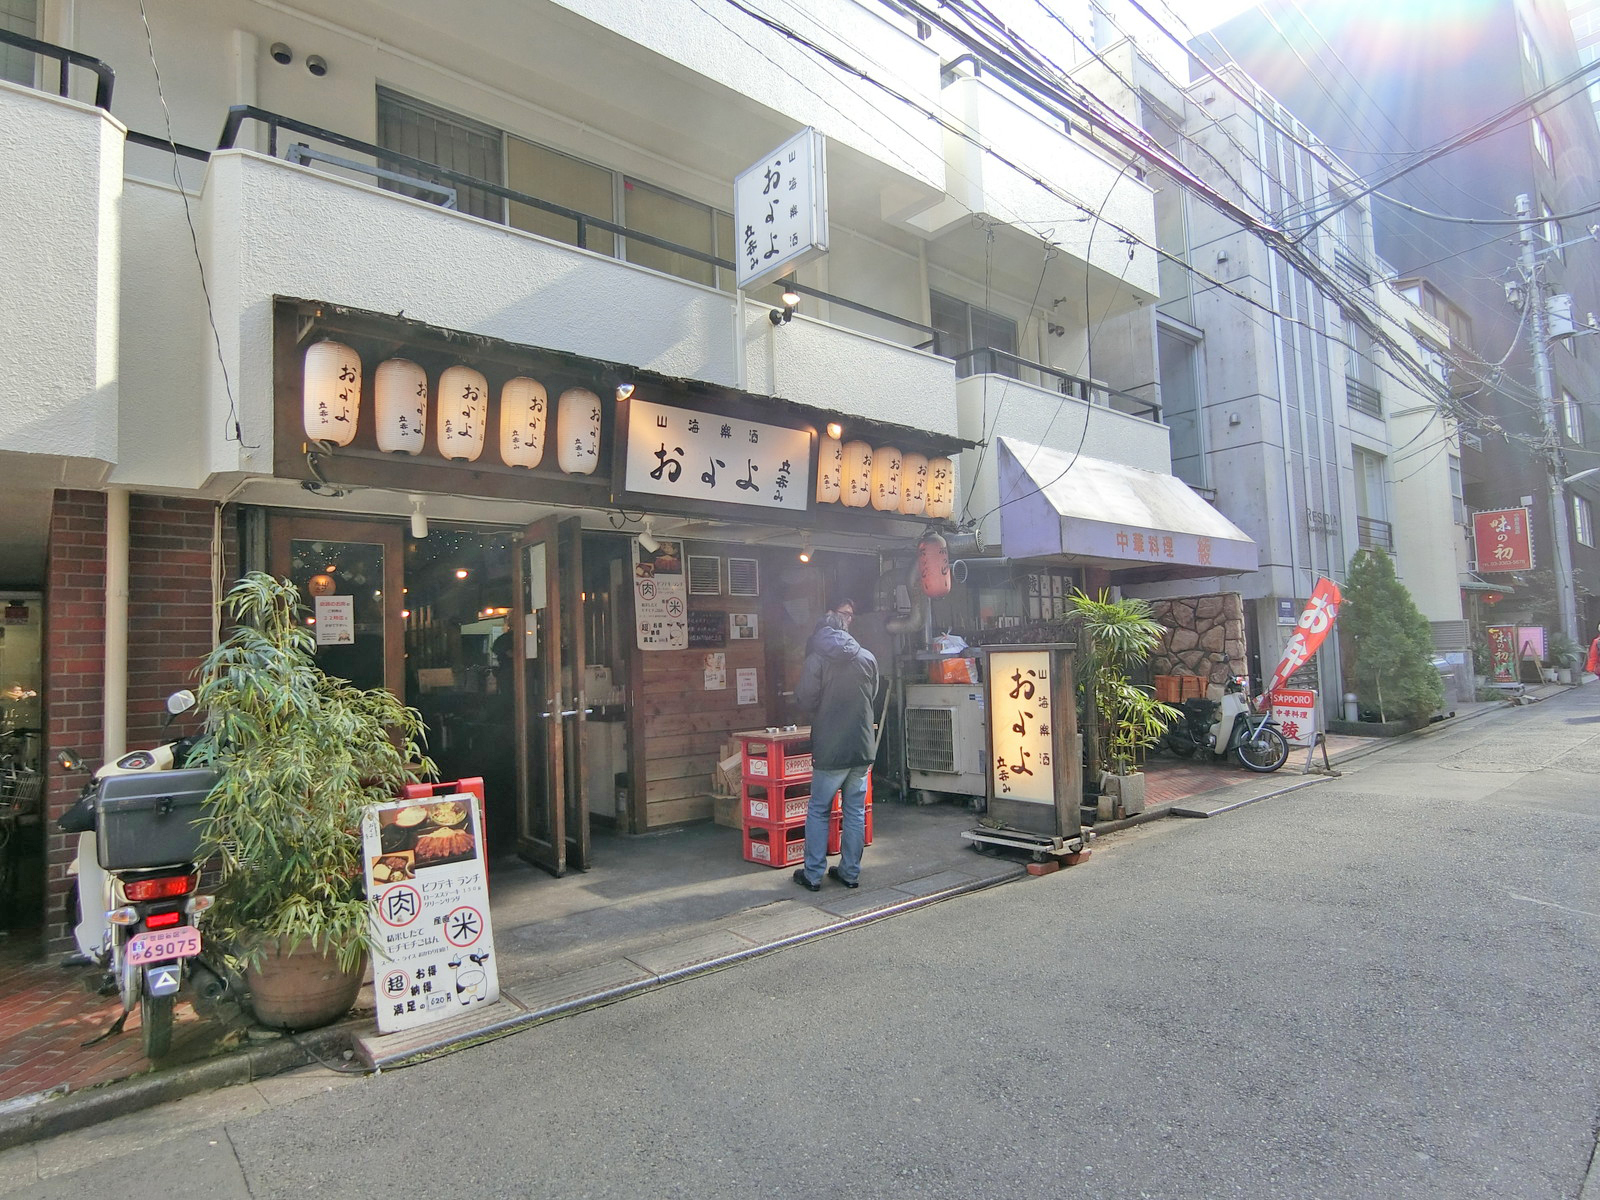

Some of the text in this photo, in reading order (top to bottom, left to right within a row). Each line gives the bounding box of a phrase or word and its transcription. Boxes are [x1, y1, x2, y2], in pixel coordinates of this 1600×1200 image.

[762, 160, 782, 260] およよ
[334, 364, 357, 423] およよ
[414, 381, 427, 436] およよ
[458, 384, 480, 438] およよ
[524, 396, 544, 448] およよ
[650, 443, 760, 492] およよ
[774, 460, 791, 502] 立呑み
[860, 454, 872, 492] およよ
[888, 459, 900, 495] およよ
[914, 464, 927, 500] およよ
[934, 468, 946, 503] およよ
[1116, 530, 1174, 558] 中華料理
[1490, 514, 1514, 560] 味の初
[642, 582, 654, 596] 肉
[670, 600, 681, 614] 米
[1493, 631, 1508, 660] 味の初
[1009, 668, 1036, 776] およよ
[1276, 709, 1308, 719] 中華料理
[1281, 720, 1301, 741] 綾
[997, 756, 1011, 793] 立呑み
[422, 874, 480, 892] ビフテキ ランチ
[388, 890, 415, 920] 肉
[387, 928, 424, 942] 精米したて
[452, 912, 478, 939] 米
[144, 939, 197, 958] 69075
[388, 936, 439, 953] モチモチごはん
[388, 974, 404, 993] 超
[416, 965, 437, 979] お得
[410, 981, 432, 996] 納得
